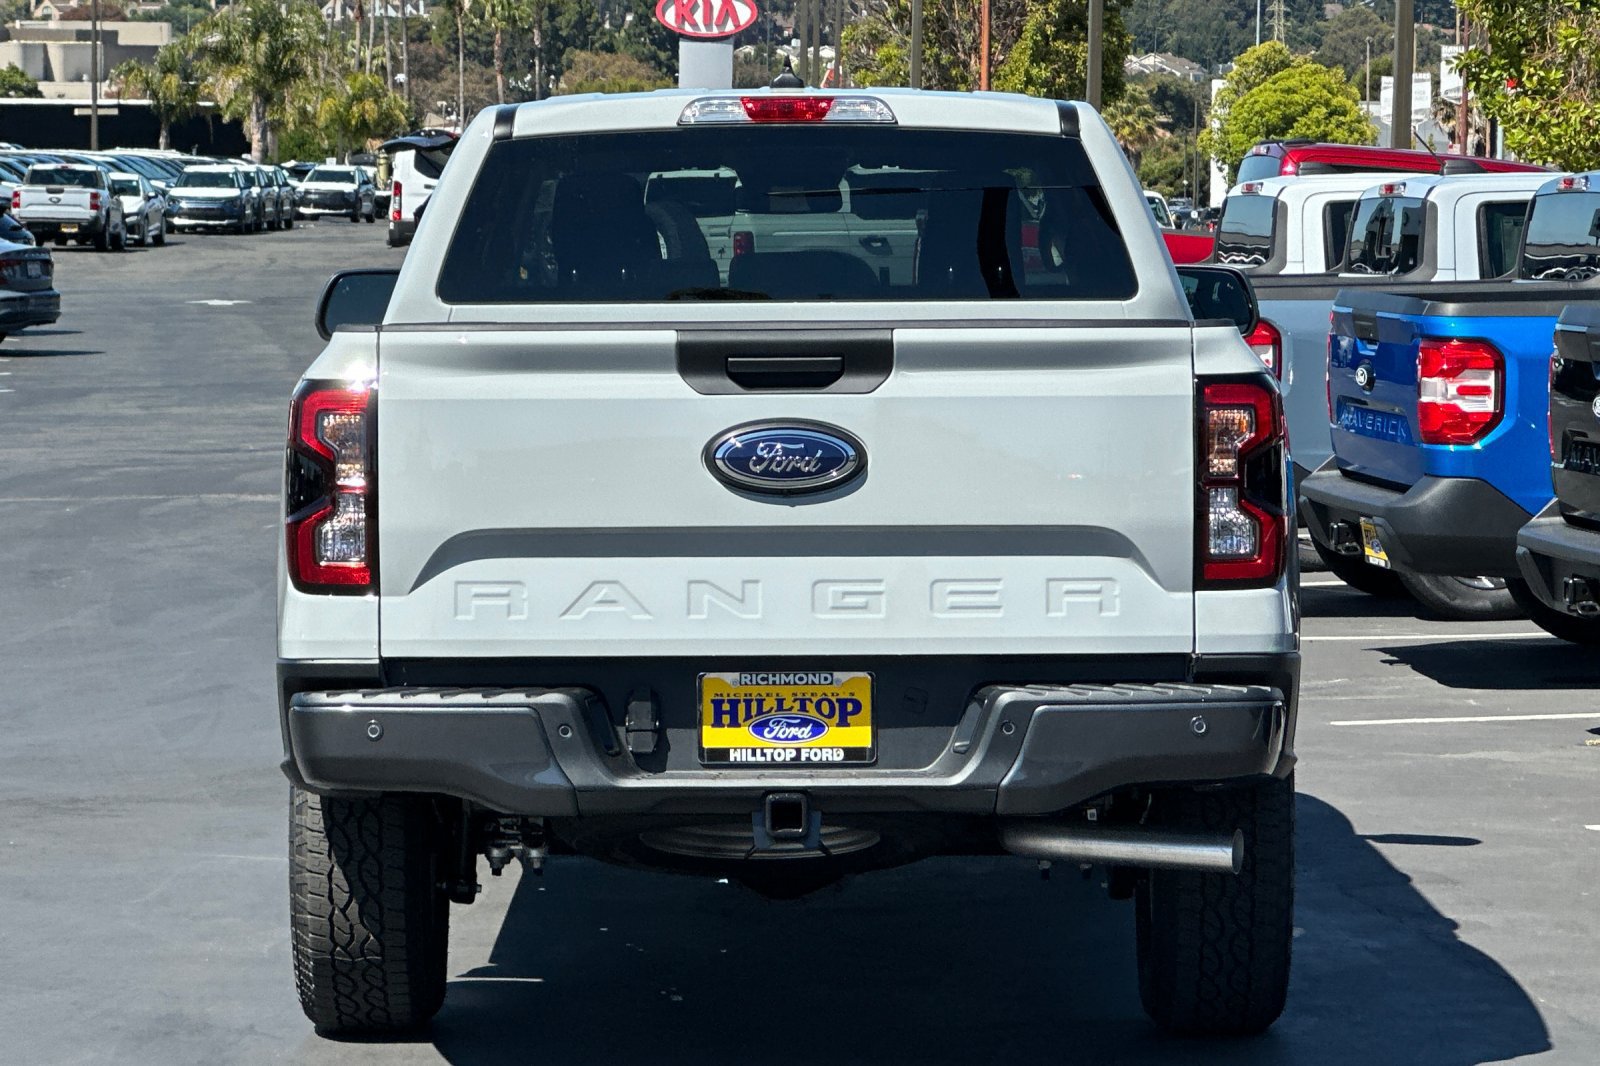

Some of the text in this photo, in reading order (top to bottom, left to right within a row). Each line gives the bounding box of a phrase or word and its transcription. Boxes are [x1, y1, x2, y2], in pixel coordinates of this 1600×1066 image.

[674, 0, 741, 28] KIA
[749, 441, 822, 473] Ford
[454, 577, 1120, 620] RANGER
[740, 673, 833, 685] RICHMOND
[710, 697, 863, 728] HILLTOP
[763, 717, 812, 739] Ford
[729, 748, 845, 762] HILLTOP FORD
